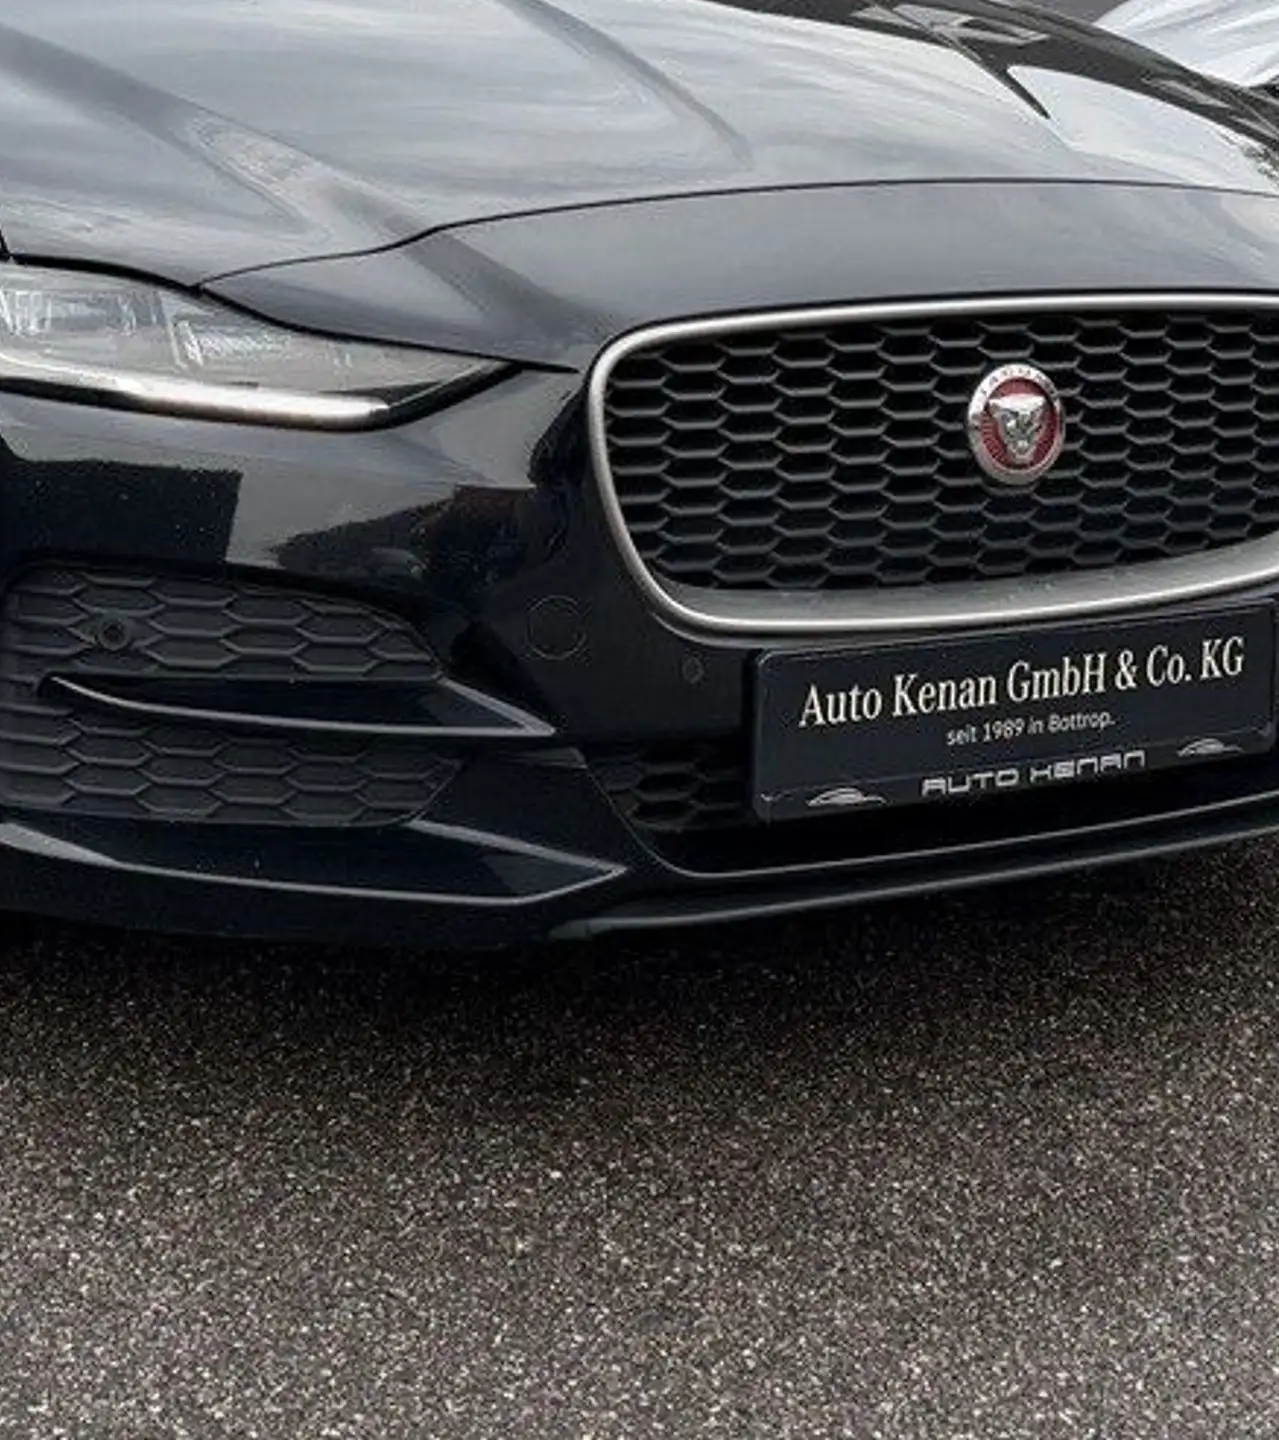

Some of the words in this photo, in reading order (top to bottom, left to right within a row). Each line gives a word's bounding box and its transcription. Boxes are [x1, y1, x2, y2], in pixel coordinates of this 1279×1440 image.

[799, 684, 883, 728] Auto
[892, 673, 997, 718] Kenan
[1007, 652, 1108, 702] GmbH
[1114, 649, 1138, 691] &
[1146, 644, 1193, 687] Co.
[1200, 636, 1244, 680] KG
[946, 724, 978, 747] seit
[983, 717, 1025, 743] 1989
[1027, 716, 1044, 735] in
[1047, 710, 1117, 734] Bottrop.
[922, 768, 1020, 797] AUTO
[1029, 749, 1146, 783] KENAN
